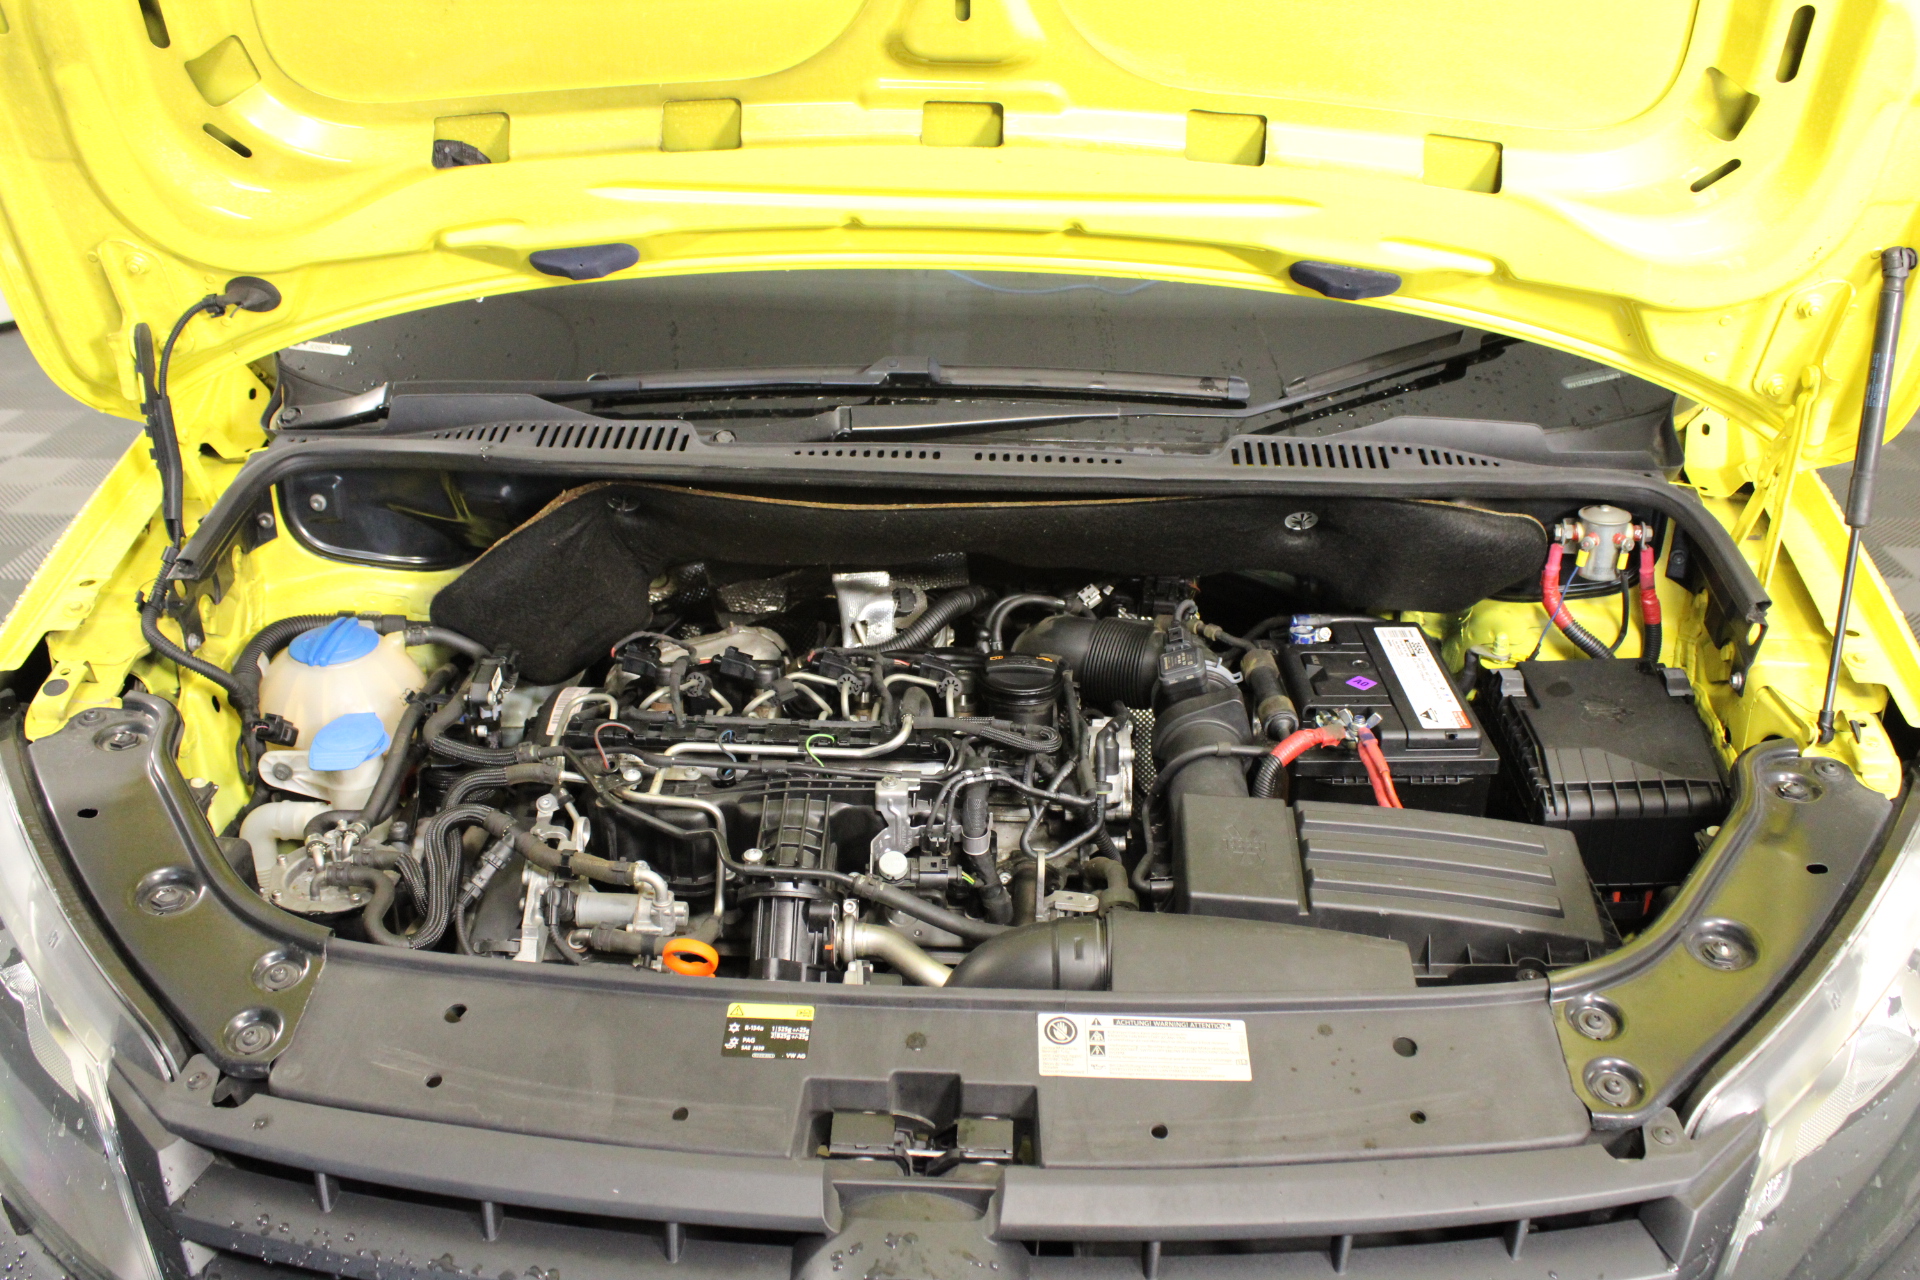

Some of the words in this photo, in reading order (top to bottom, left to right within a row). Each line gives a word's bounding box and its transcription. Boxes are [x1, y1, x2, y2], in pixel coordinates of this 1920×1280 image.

[1116, 1019, 1151, 1027] ACHTUNG!
[1153, 1020, 1187, 1028] WARNING!
[744, 1024, 764, 1032] R-134a
[742, 1036, 756, 1044] PAG
